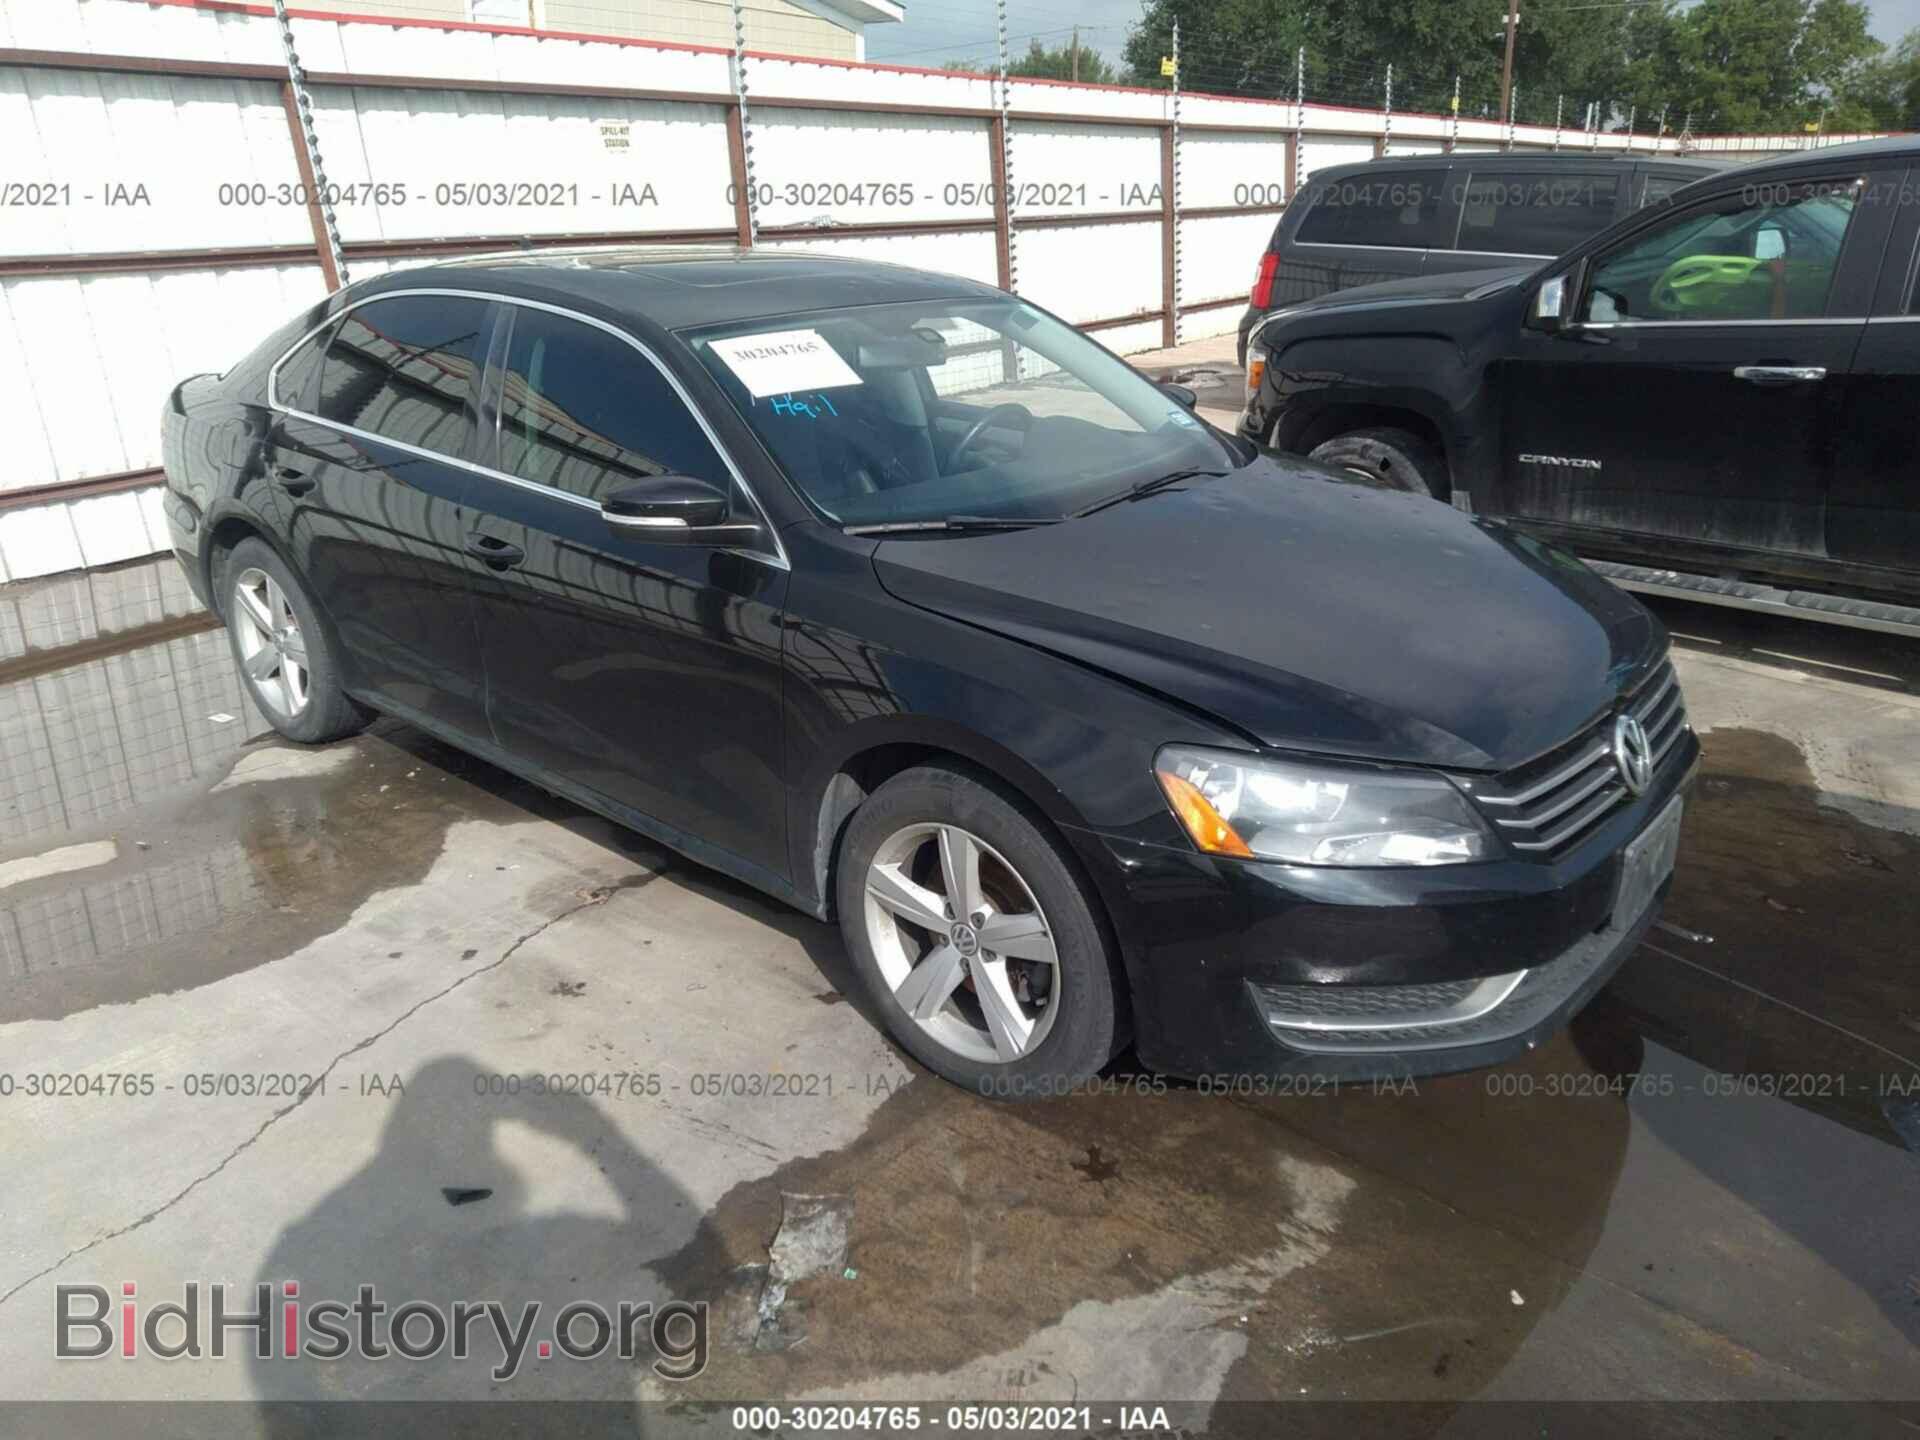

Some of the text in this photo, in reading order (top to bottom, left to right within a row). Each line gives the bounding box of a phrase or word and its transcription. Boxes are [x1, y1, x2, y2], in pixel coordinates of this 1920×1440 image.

[604, 138, 629, 148] STATION
[733, 341, 819, 362] 30204765
[1519, 453, 1602, 469] CANYON
